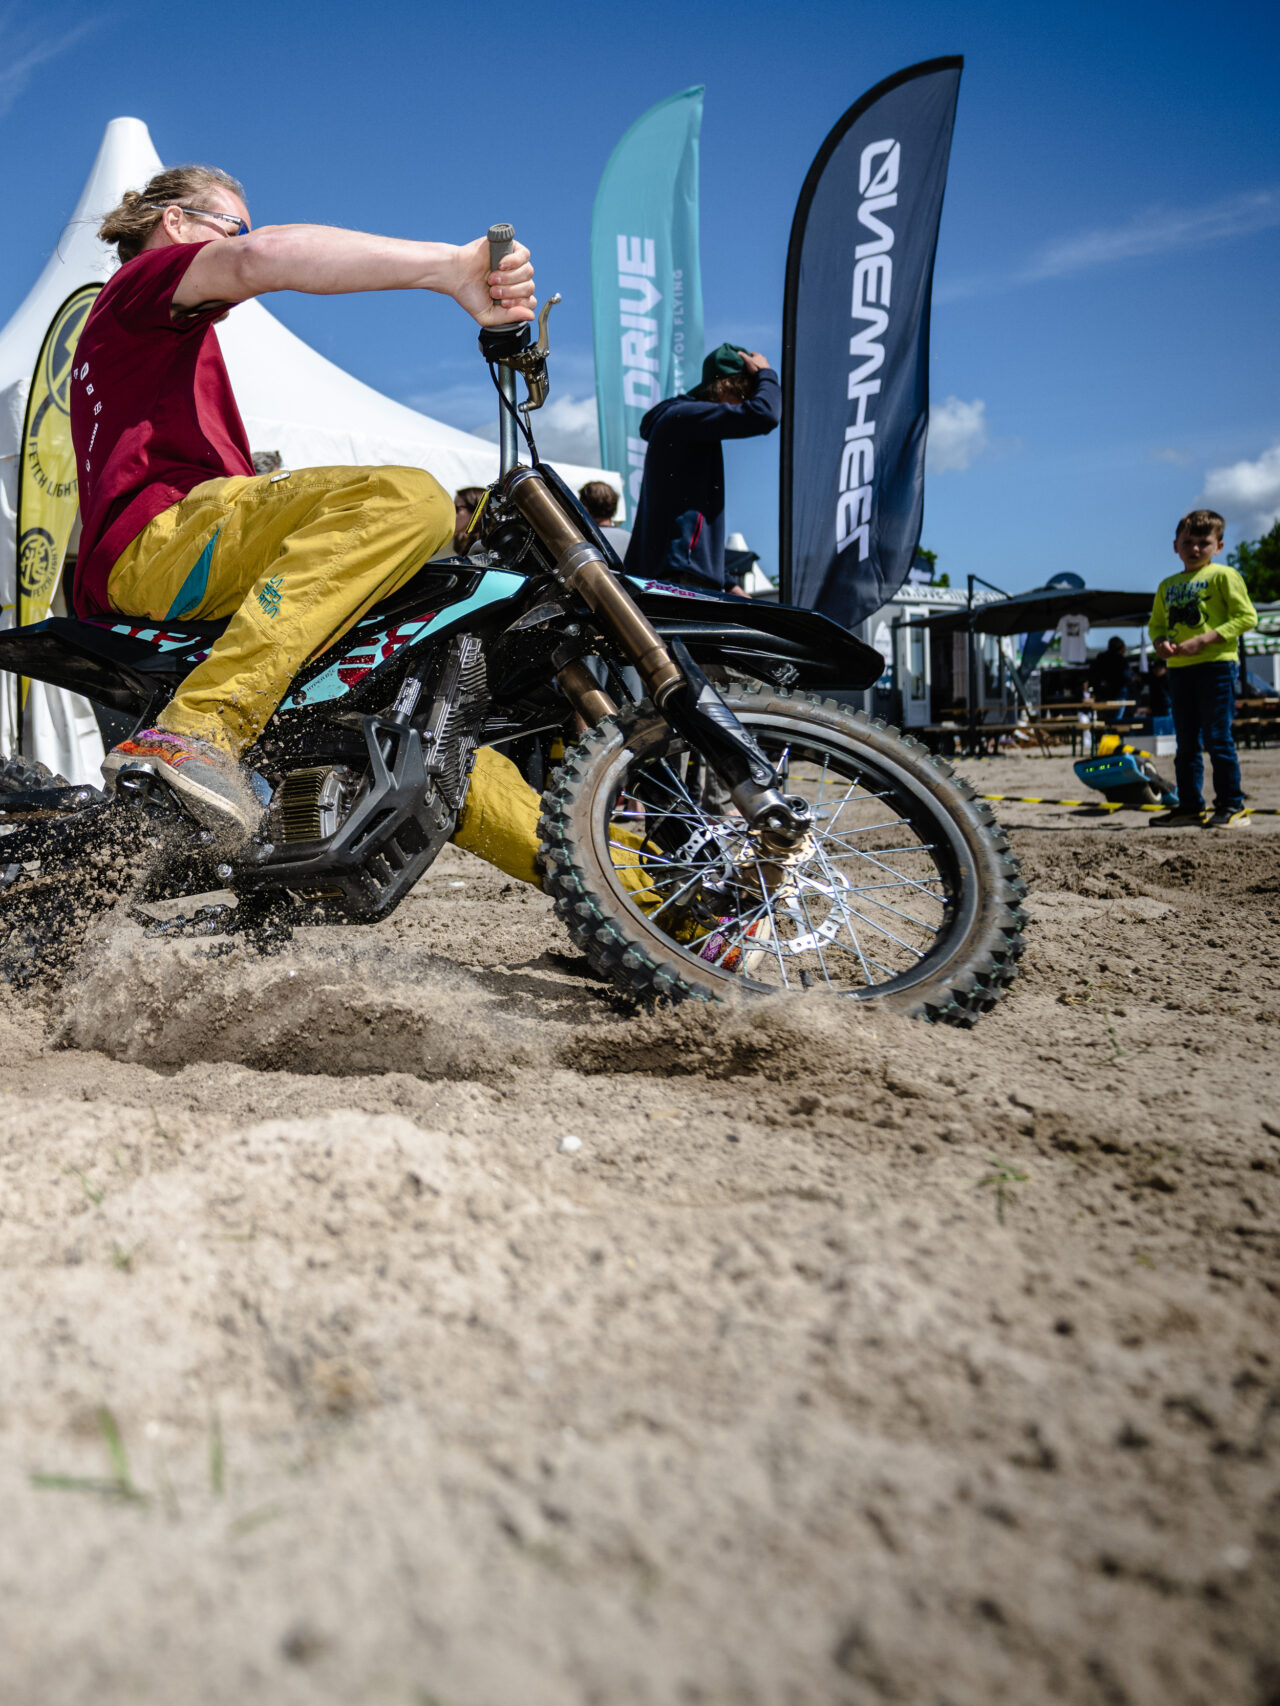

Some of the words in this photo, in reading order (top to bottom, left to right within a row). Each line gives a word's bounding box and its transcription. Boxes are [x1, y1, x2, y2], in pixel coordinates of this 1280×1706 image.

[616, 233, 663, 411] DRIVE
[673, 269, 684, 326] FLYING
[28, 442, 48, 488] FETCH
[46, 478, 78, 498] LIGHT
